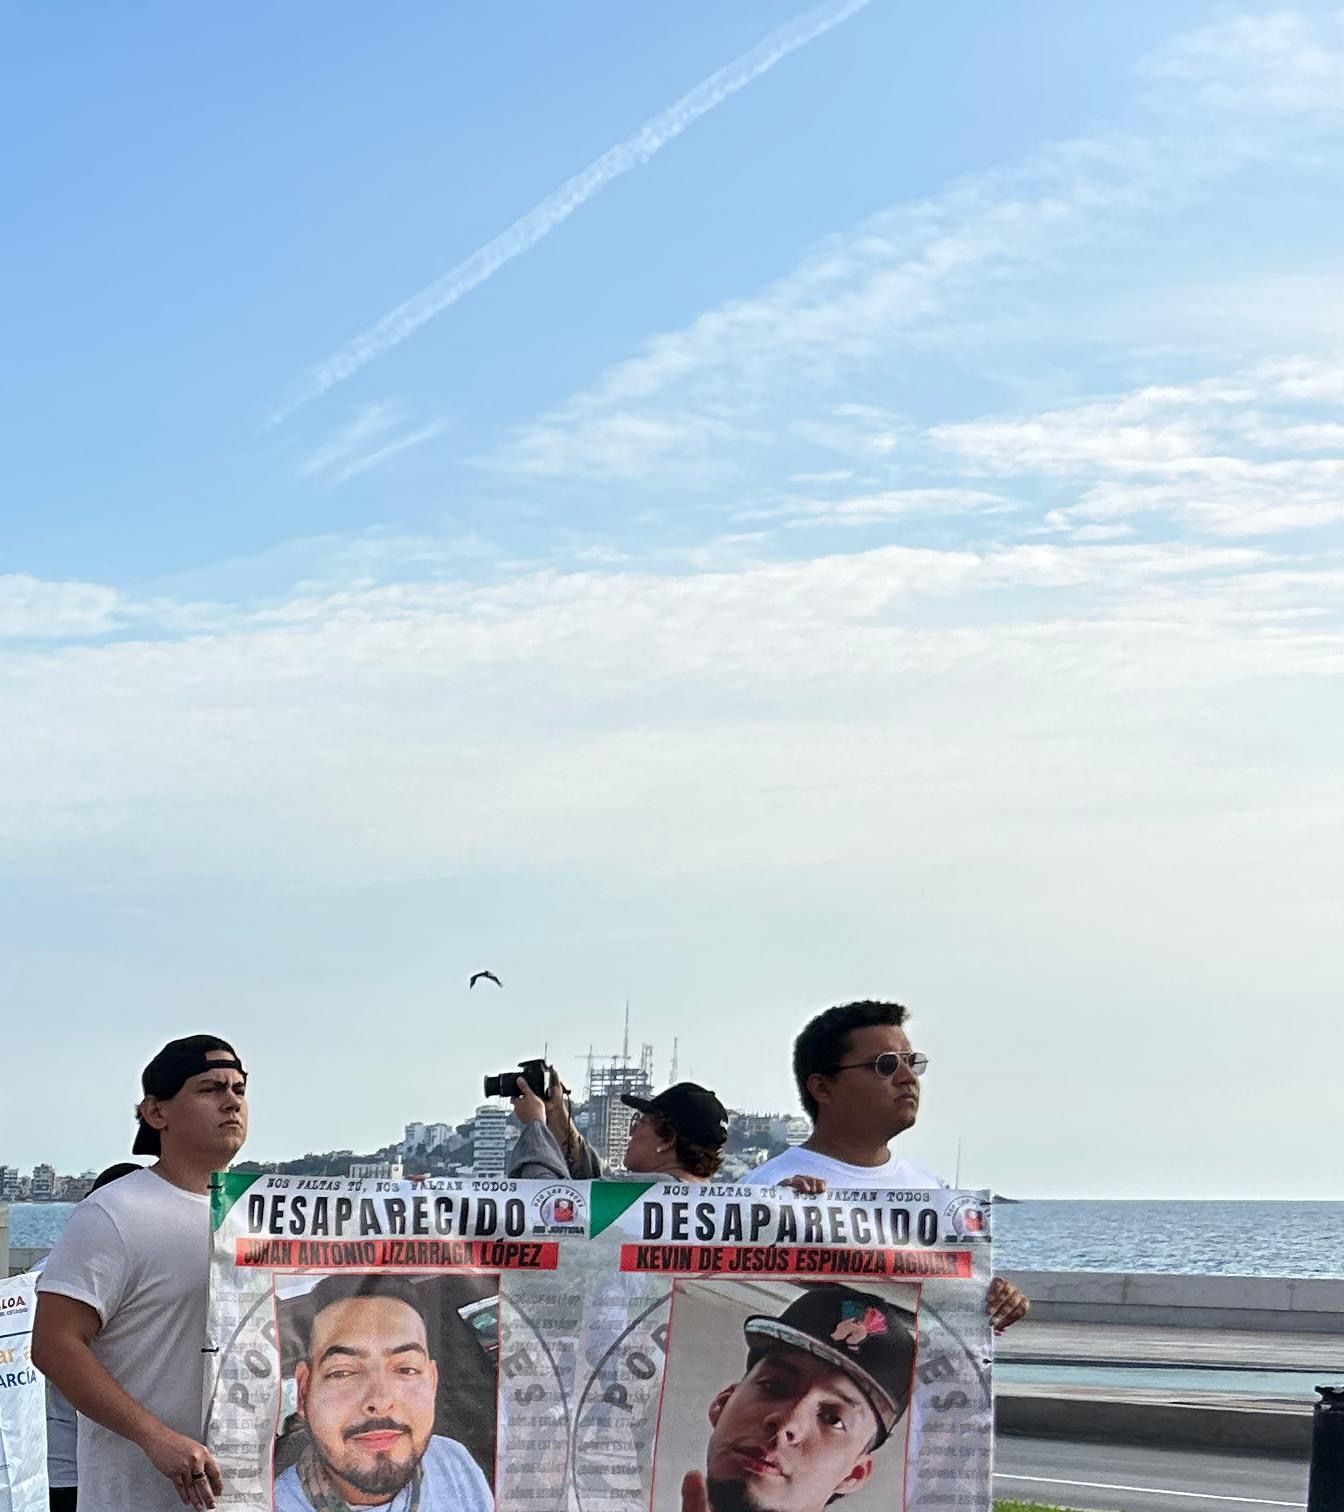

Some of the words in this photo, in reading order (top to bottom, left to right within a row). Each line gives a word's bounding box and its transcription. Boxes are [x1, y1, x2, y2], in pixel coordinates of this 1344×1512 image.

[248, 1193, 526, 1239] DESAPARECIDO
[641, 1200, 938, 1247] DESAPARECIDO
[297, 1240, 377, 1266] ANTONIO
[381, 1240, 472, 1267] LIZARRAGA
[477, 1237, 543, 1267] LÓPEZ
[636, 1244, 693, 1271] KEVIN
[697, 1245, 723, 1271] DE
[726, 1242, 787, 1272] JESÚS
[795, 1248, 887, 1273] ESPINOZA
